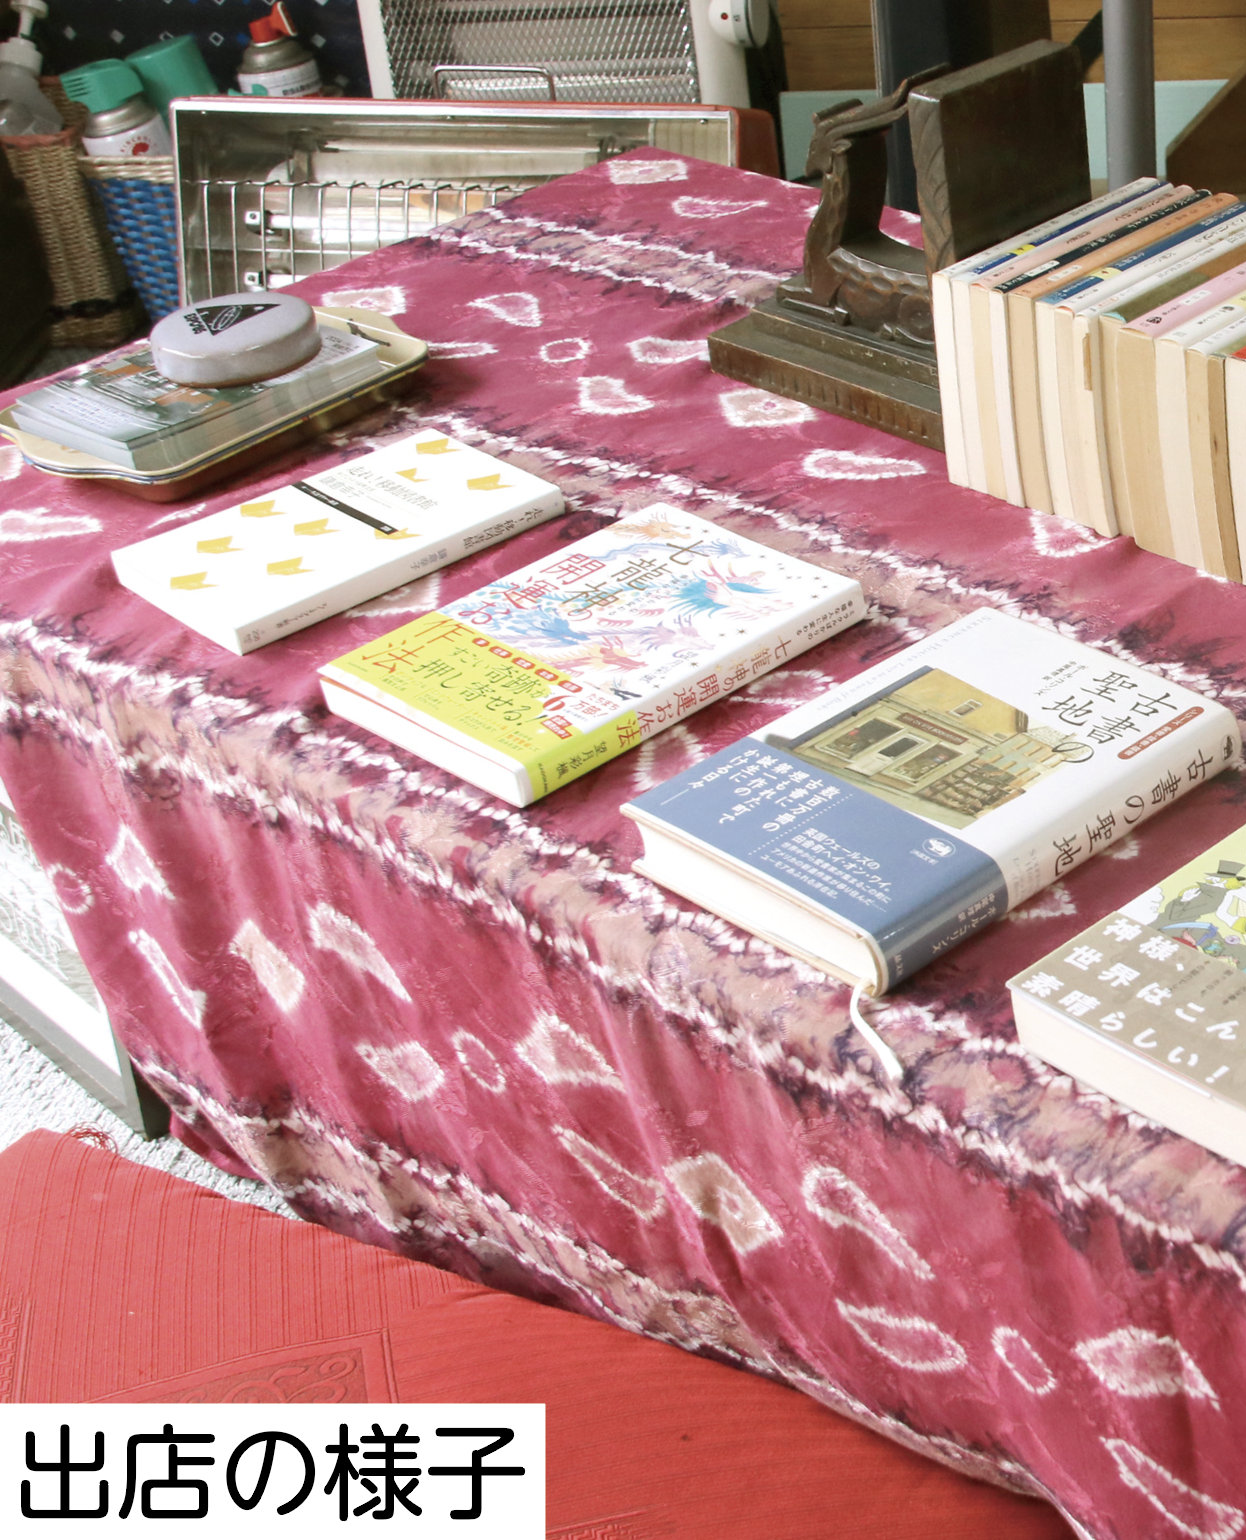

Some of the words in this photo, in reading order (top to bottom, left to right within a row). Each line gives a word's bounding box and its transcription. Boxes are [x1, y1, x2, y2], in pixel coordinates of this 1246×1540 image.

[356, 548, 610, 678] 開運お作法
[434, 642, 564, 704] すごい奇跡が
[613, 627, 794, 753] 七龍神の開運お作法
[1036, 667, 1150, 728] 聖地
[1041, 685, 1191, 770] 古書の
[710, 768, 813, 826] 埋もれた町で
[725, 754, 781, 784] 誕生に
[730, 761, 796, 798] 第一作の
[771, 776, 828, 808] 古書に
[757, 784, 845, 834] 数百万冊の
[1044, 742, 1218, 877] 古書の聖地
[798, 826, 886, 871] 英国ウェールズの
[1096, 915, 1205, 973] 神様、
